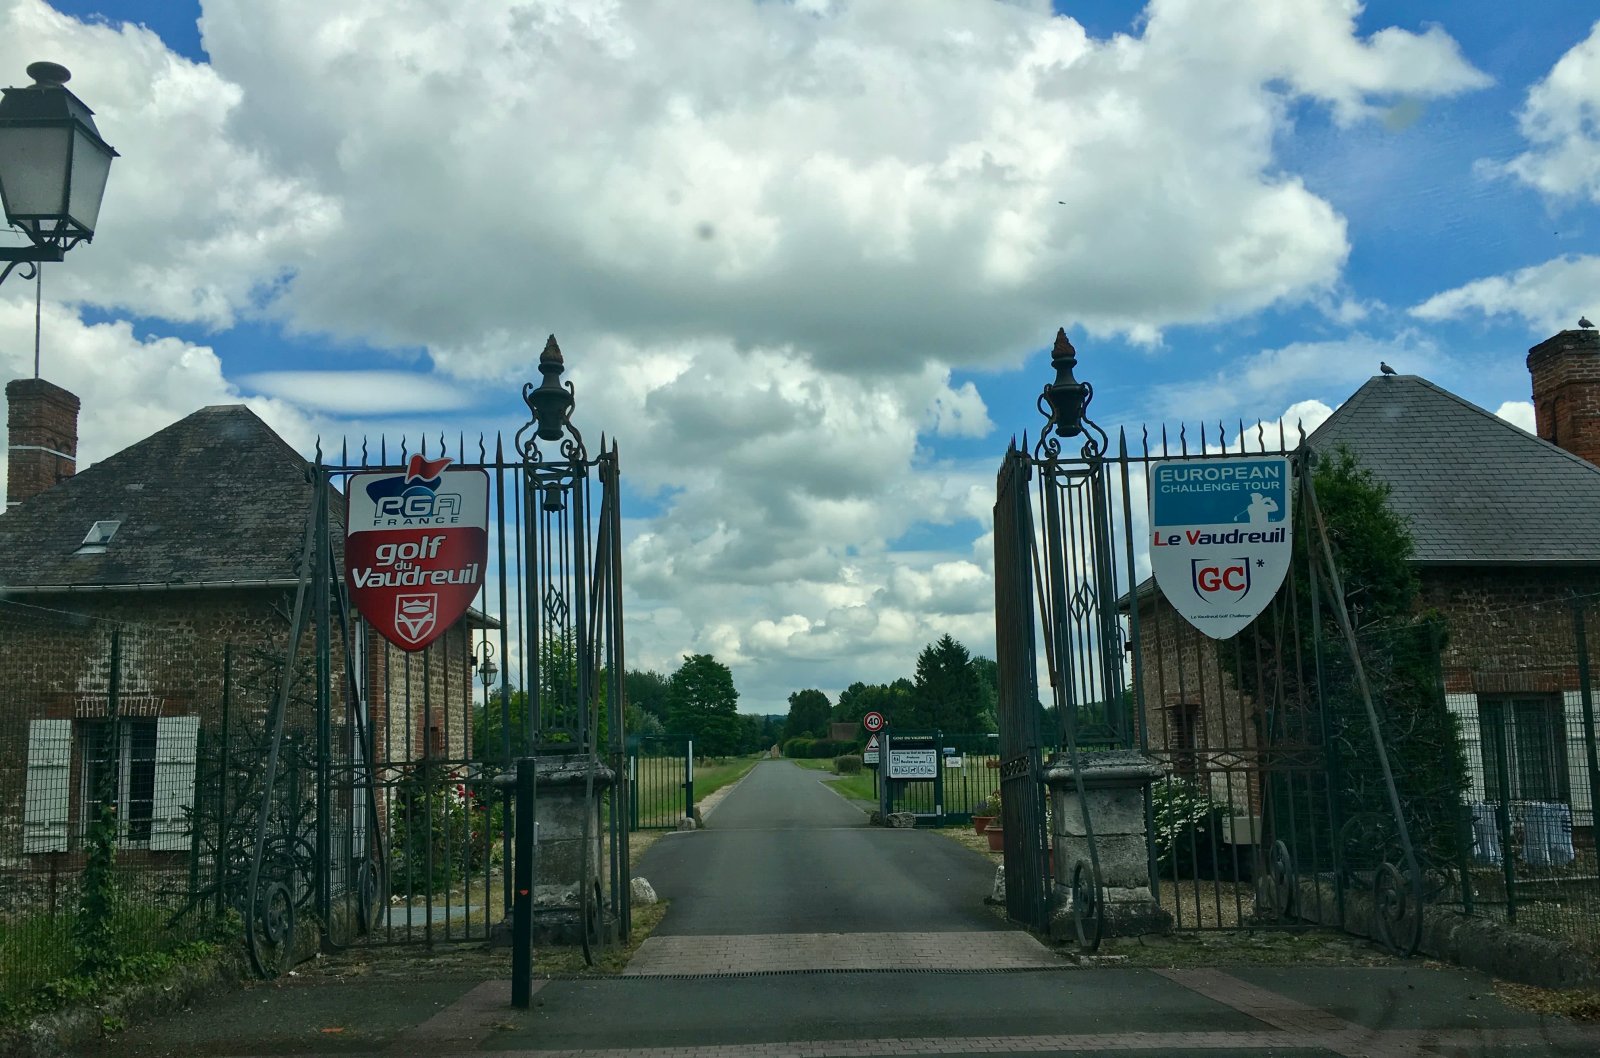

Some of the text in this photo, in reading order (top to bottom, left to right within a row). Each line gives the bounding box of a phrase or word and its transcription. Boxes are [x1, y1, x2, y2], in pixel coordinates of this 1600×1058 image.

[1160, 465, 1280, 482] EUROPEAN
[1161, 481, 1280, 494] CHALLENGE TOUR
[374, 493, 462, 519] PGA
[373, 516, 460, 527] FRANCE
[1153, 527, 1286, 547] Le Vaudreuil
[375, 535, 447, 567] golf
[394, 560, 413, 571] du
[352, 563, 479, 589] Vaudreuil
[868, 718, 880, 726] 40
